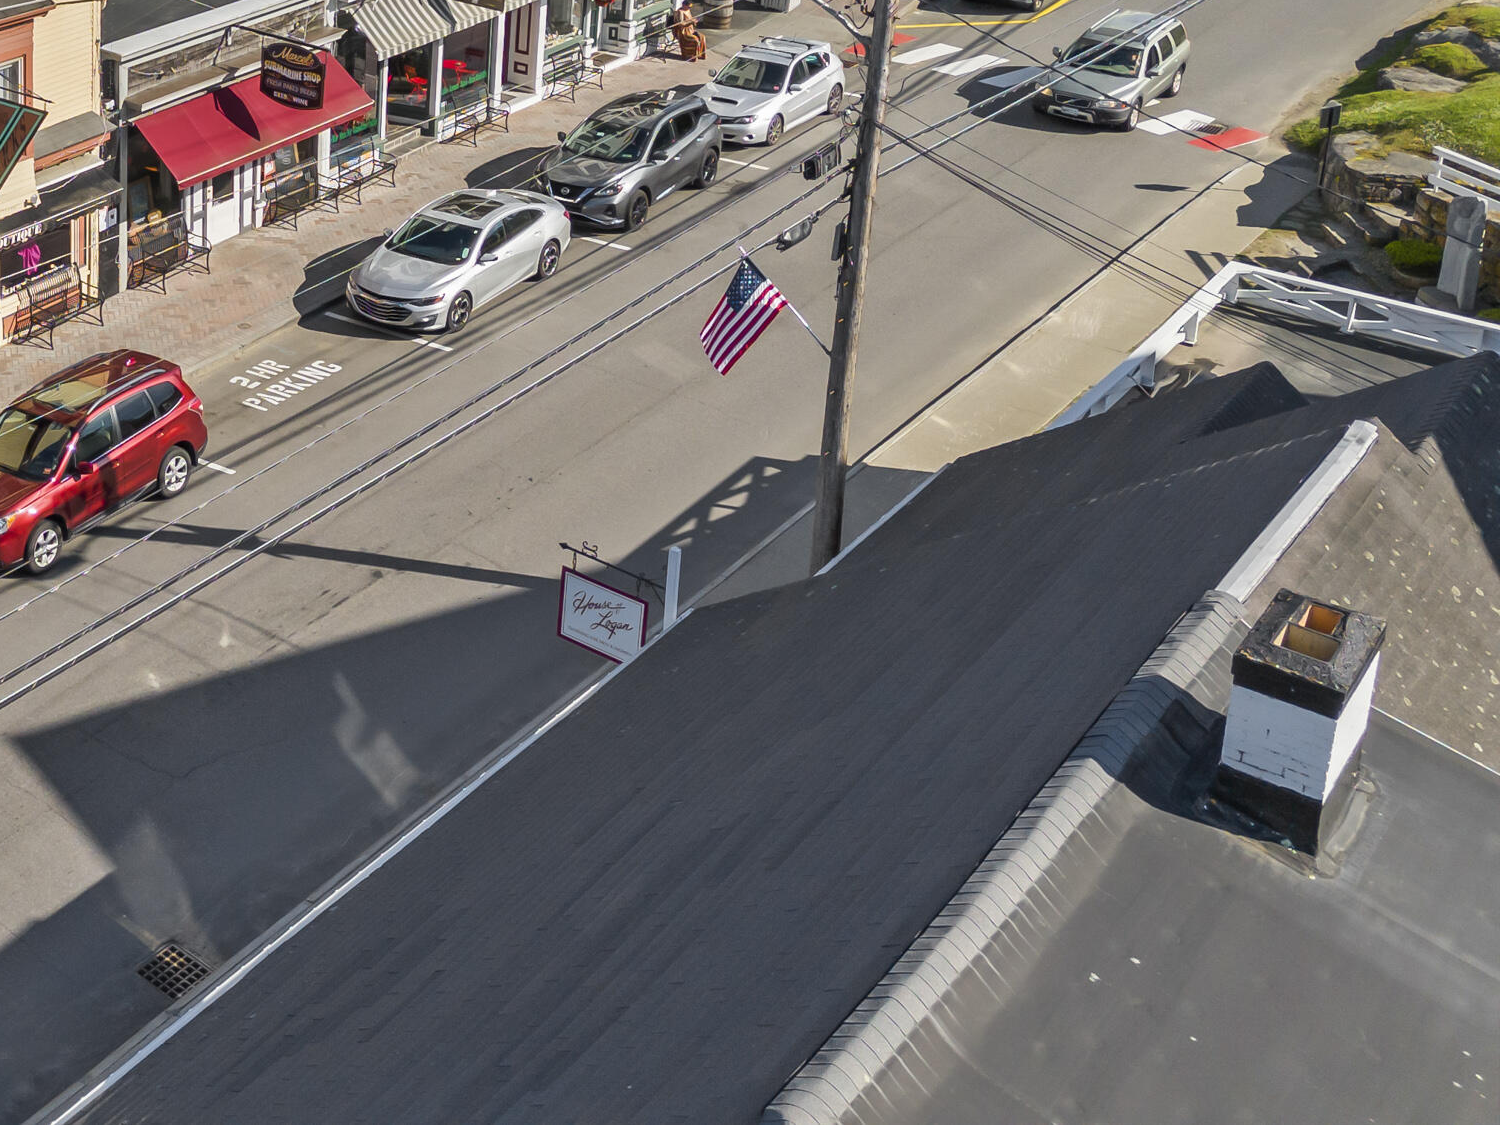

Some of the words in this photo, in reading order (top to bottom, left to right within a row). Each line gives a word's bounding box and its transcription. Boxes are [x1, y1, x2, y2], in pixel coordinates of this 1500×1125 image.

[264, 59, 303, 81] SUBMARINE
[303, 71, 322, 84] SHOP
[292, 96, 309, 106] WINE
[228, 375, 261, 389] 2
[245, 359, 291, 380] HR
[242, 359, 343, 412] PARKING
[572, 590, 625, 616] House
[590, 611, 633, 640] Logan
